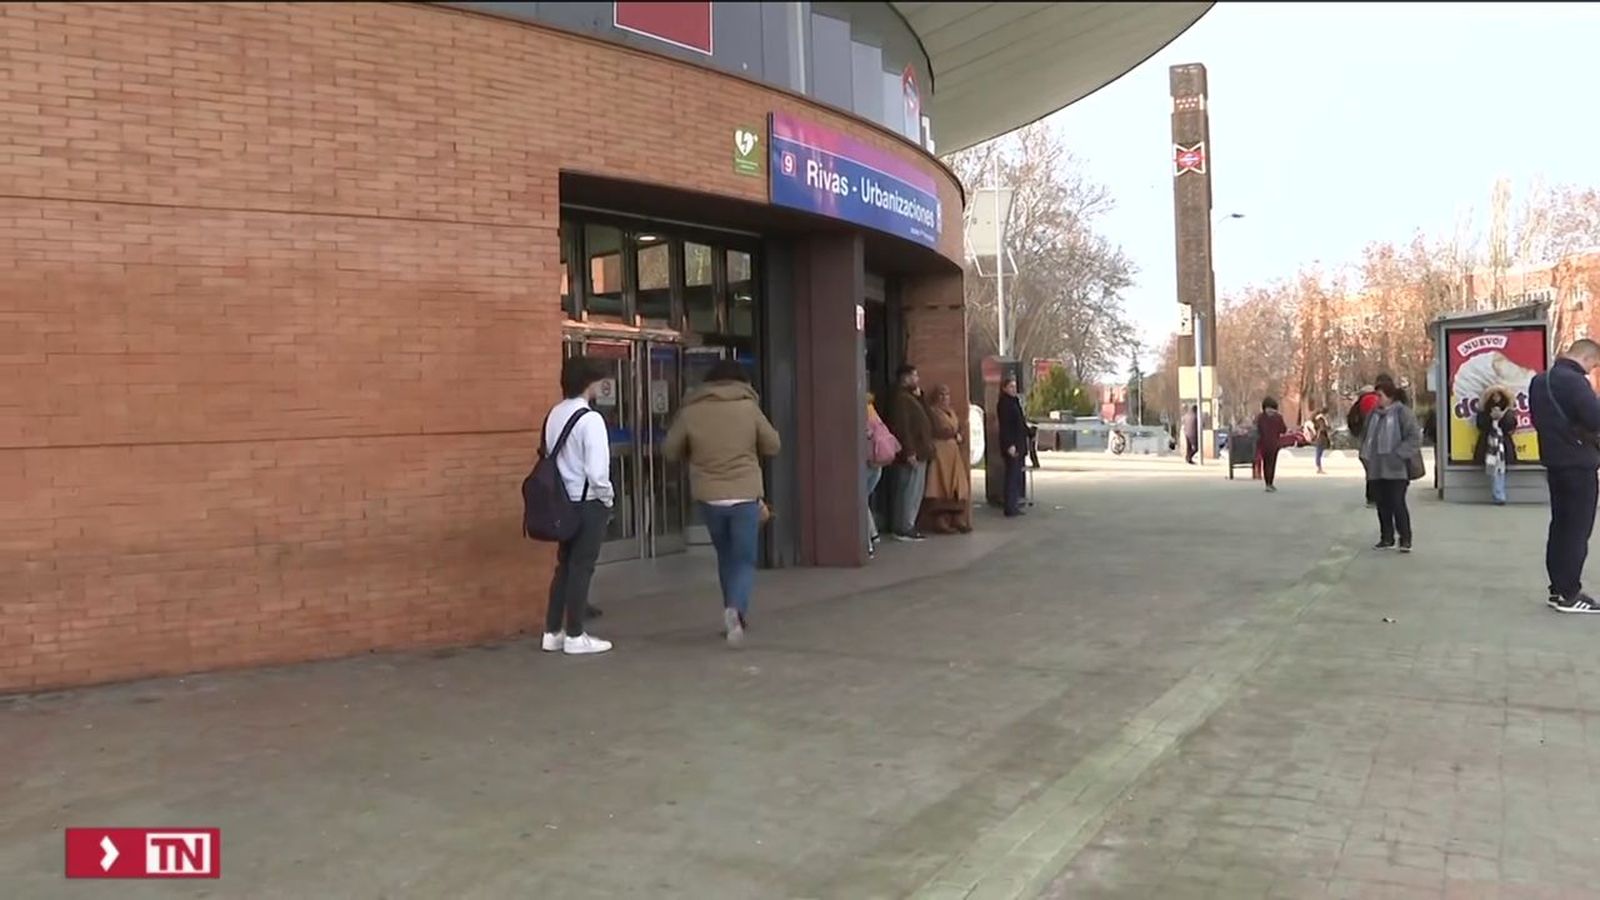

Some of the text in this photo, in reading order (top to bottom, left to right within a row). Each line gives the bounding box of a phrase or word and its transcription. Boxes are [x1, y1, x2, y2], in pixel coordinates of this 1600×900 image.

[784, 154, 793, 173] 9
[807, 159, 849, 196] Rivas
[860, 176, 935, 229] Urbanizaciones
